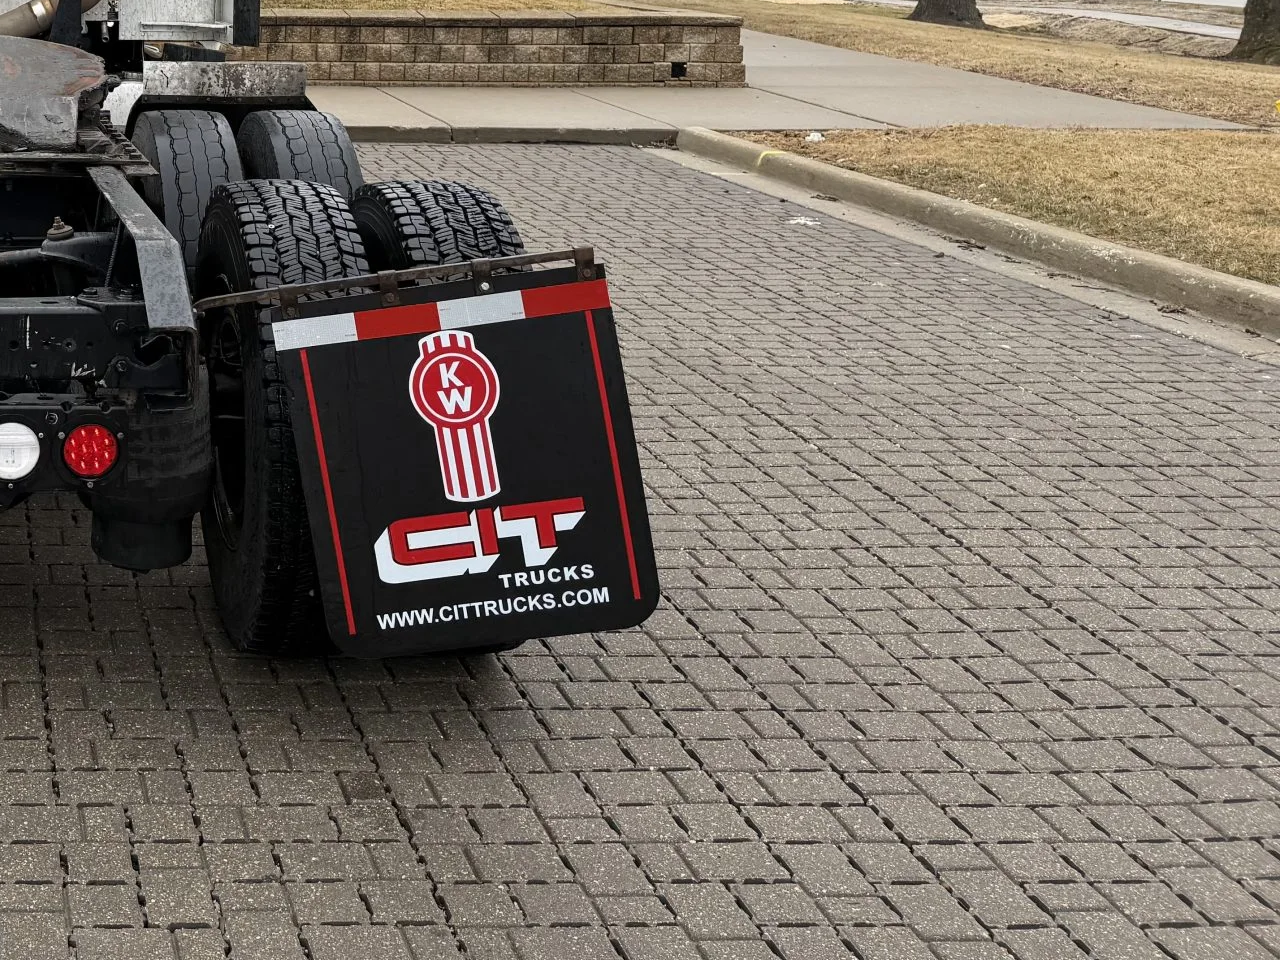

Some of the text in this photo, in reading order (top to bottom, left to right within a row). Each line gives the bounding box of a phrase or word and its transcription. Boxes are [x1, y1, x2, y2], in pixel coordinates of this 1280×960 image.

[373, 496, 587, 585] CIT
[497, 564, 596, 589] TRUCKS
[376, 586, 610, 630] WWW.CITTRUCKS.COM
